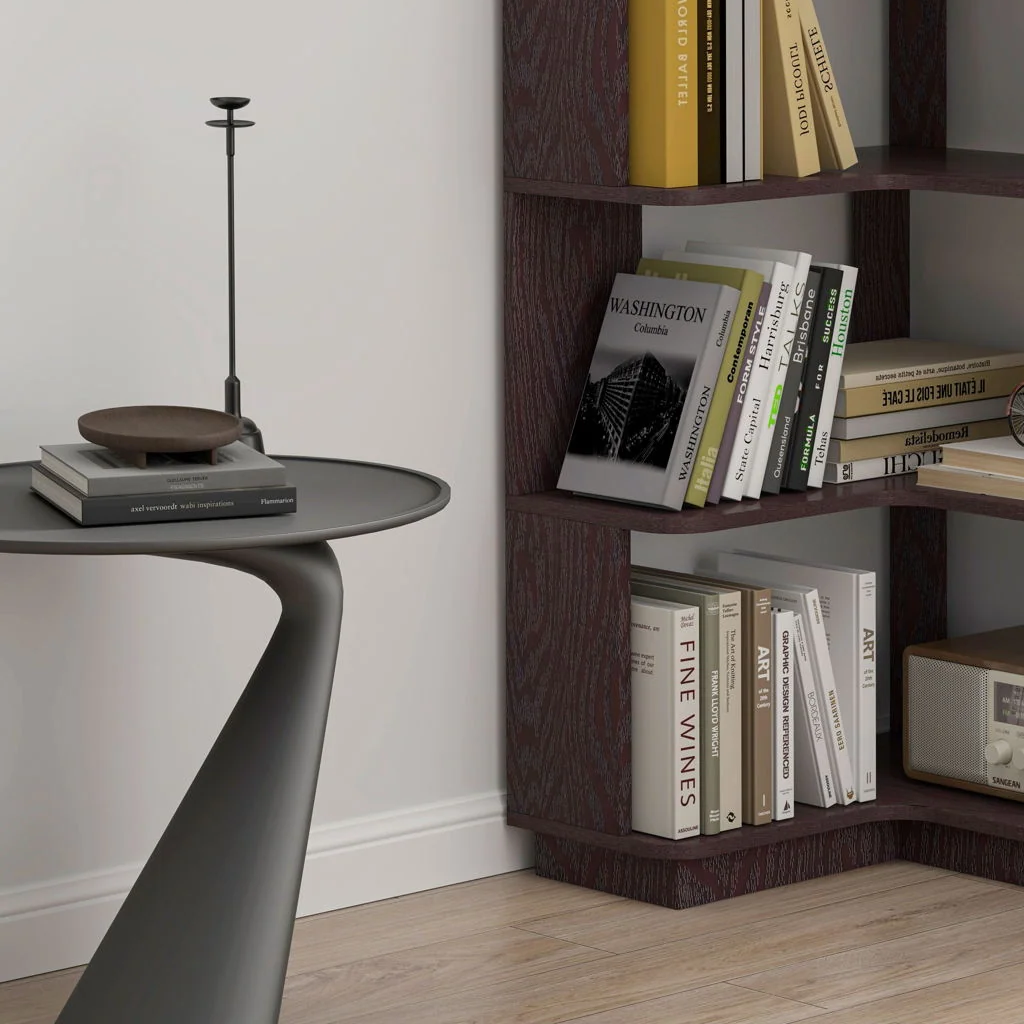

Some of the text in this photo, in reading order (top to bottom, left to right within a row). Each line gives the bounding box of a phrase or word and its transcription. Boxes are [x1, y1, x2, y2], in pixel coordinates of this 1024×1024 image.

[610, 297, 708, 323] WASHINGTON
[634, 322, 668, 336] Columbia
[727, 301, 754, 383] Contemporan
[737, 306, 767, 405] FORM STYLE
[678, 310, 731, 481] WASHINGTON Columbia
[735, 281, 790, 481] State Capital Harrisburg
[768, 384, 783, 429] TED
[773, 288, 816, 478] Queensland Brisbane
[800, 288, 837, 471] FORMULA FOR SUCCESS
[814, 288, 853, 466] Tehas Houston
[131, 500, 234, 513] axel vervoordt wabi inspirations
[261, 497, 293, 505] Flammarion
[758, 647, 770, 680] ART
[863, 628, 874, 662] ART
[680, 641, 695, 807] FINE WINES
[992, 777, 1020, 789] SANGEAN
